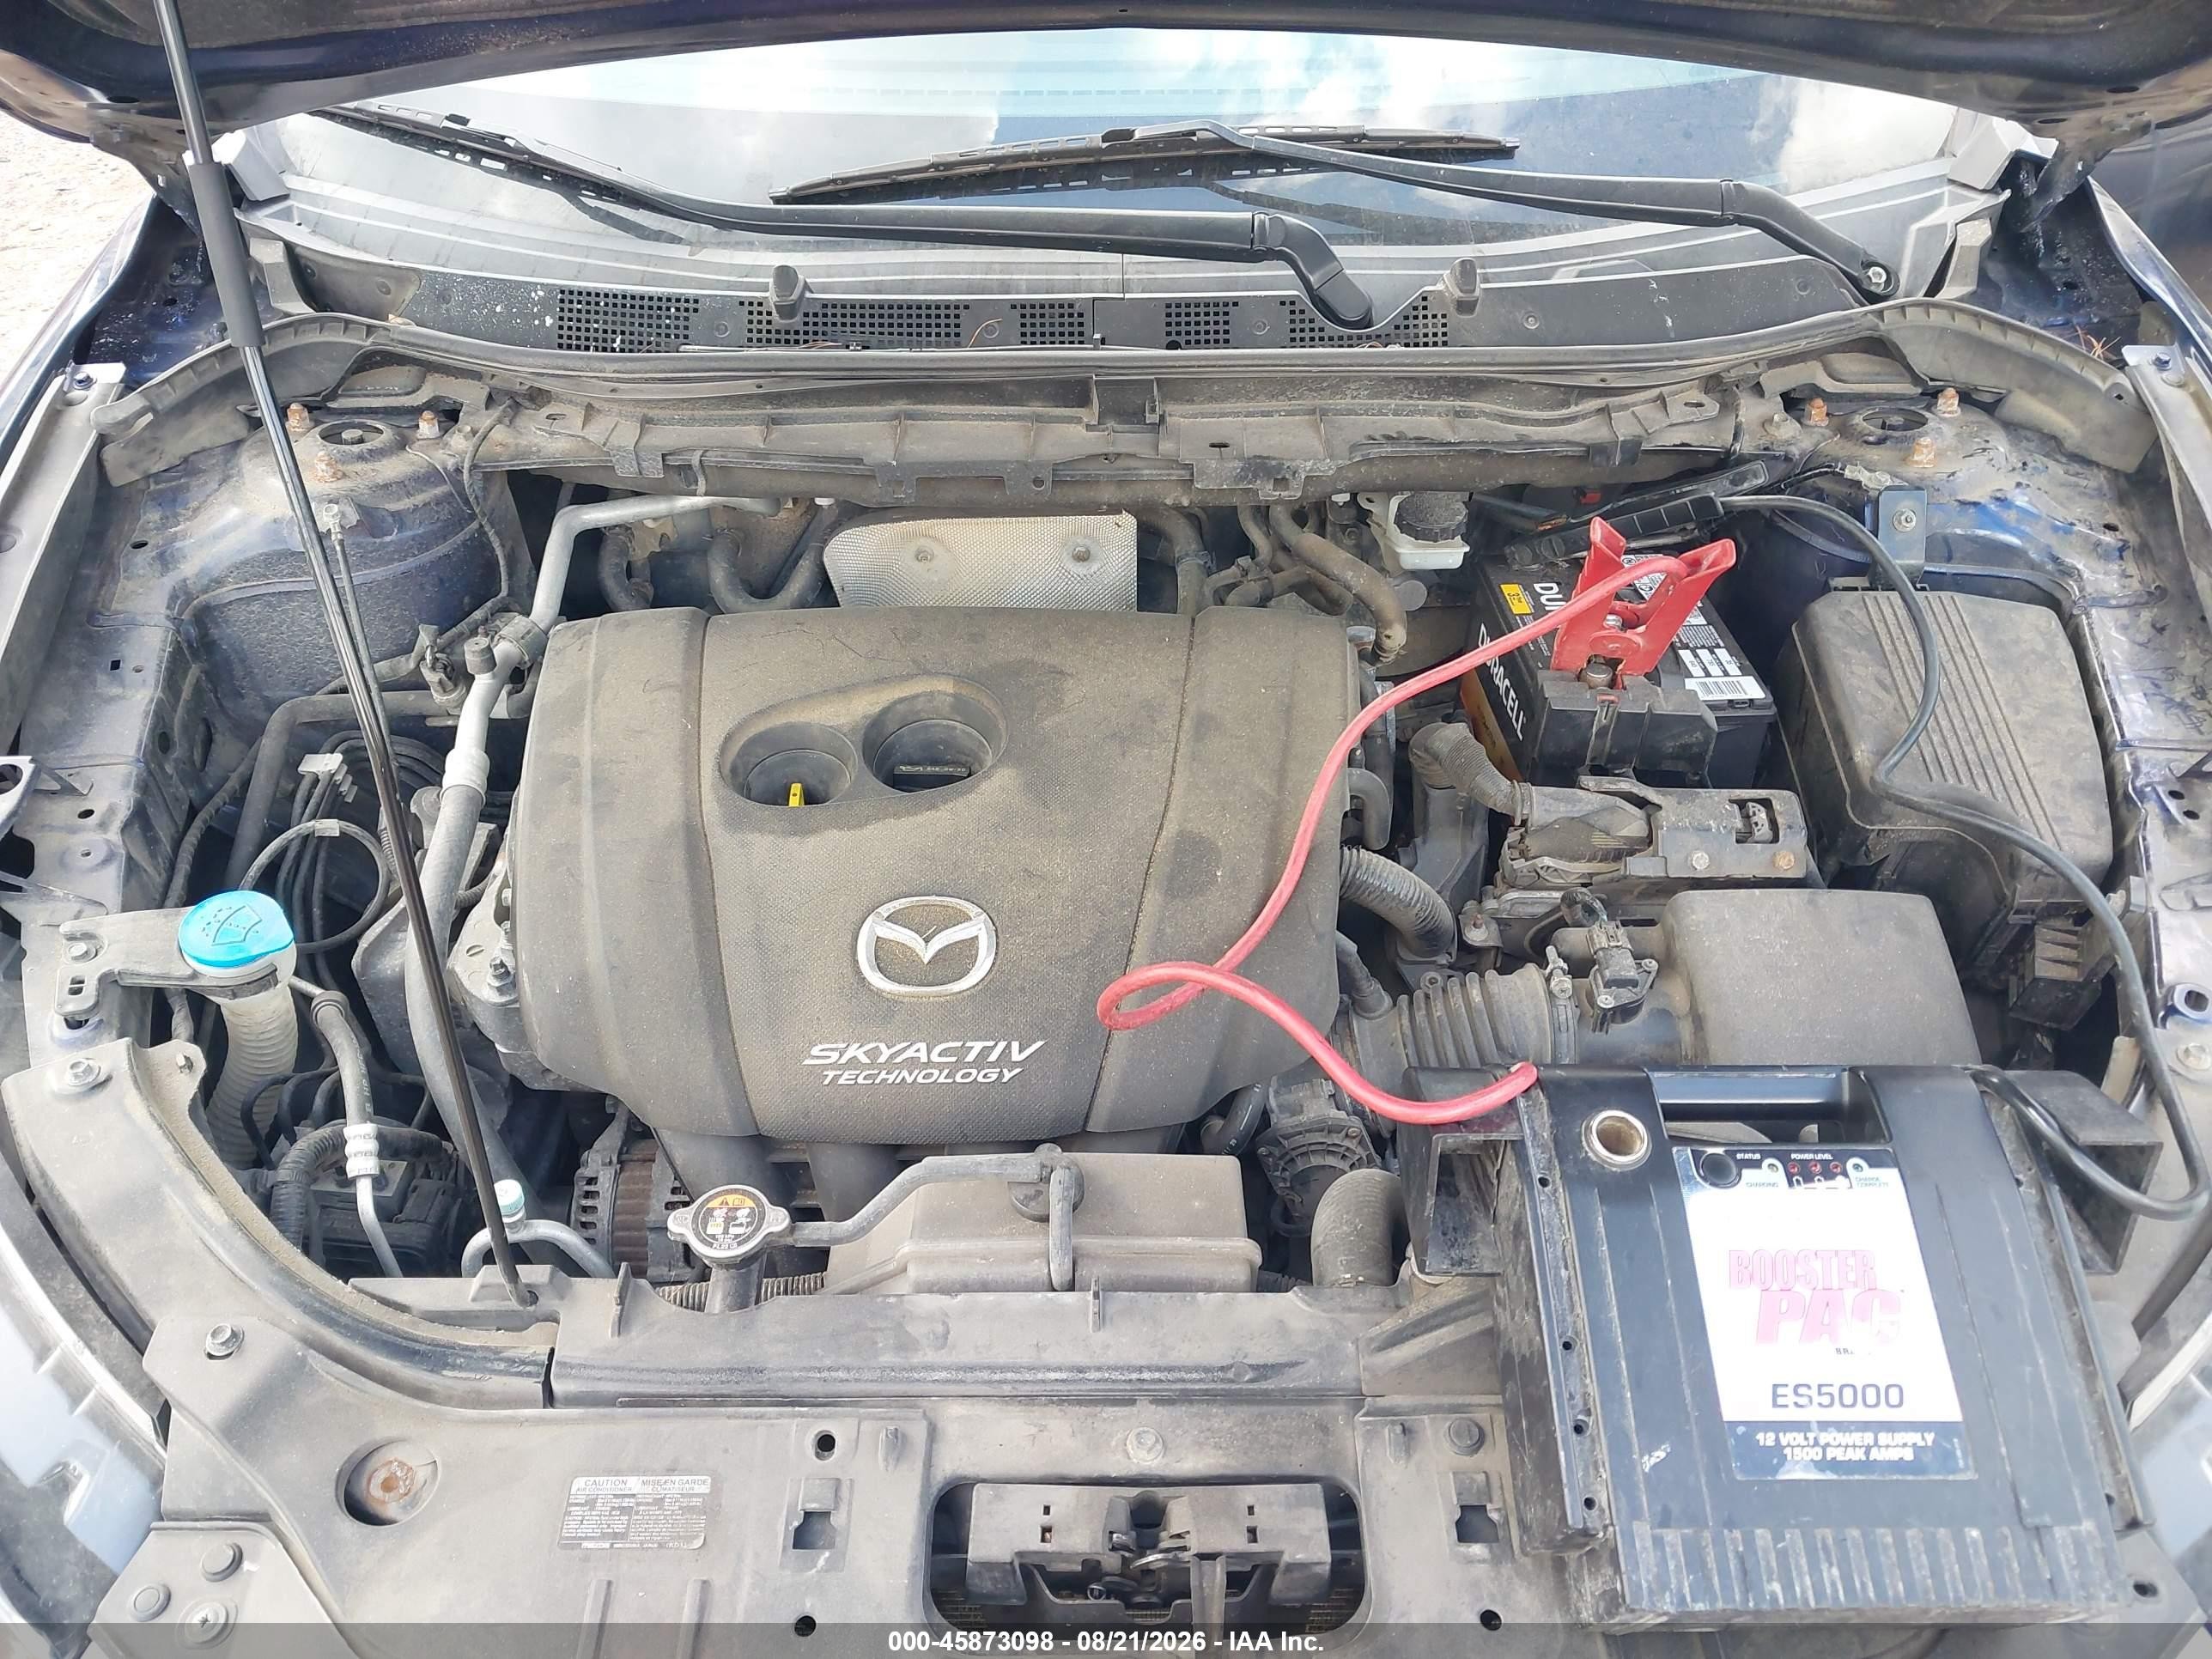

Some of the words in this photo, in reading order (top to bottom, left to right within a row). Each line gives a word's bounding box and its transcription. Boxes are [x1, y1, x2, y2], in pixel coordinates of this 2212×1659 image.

[802, 1039, 1049, 1065] SKYACTIV
[822, 1067, 1024, 1085] TECHNOLOGY
[1729, 1249, 1877, 1291] BOOSTER
[1755, 1289, 1901, 1346] PAC
[1771, 1383, 1904, 1409] ES5000
[1755, 1432, 1775, 1446] 12
[1778, 1432, 1816, 1446] VOLT
[1819, 1432, 1875, 1446] POWER
[1877, 1432, 1935, 1446] SUPPLY
[1784, 1447, 1822, 1462] 1500
[1826, 1447, 1867, 1462] PEAK
[1869, 1447, 1914, 1462] AMPS
[584, 1479, 628, 1487] CAUTION
